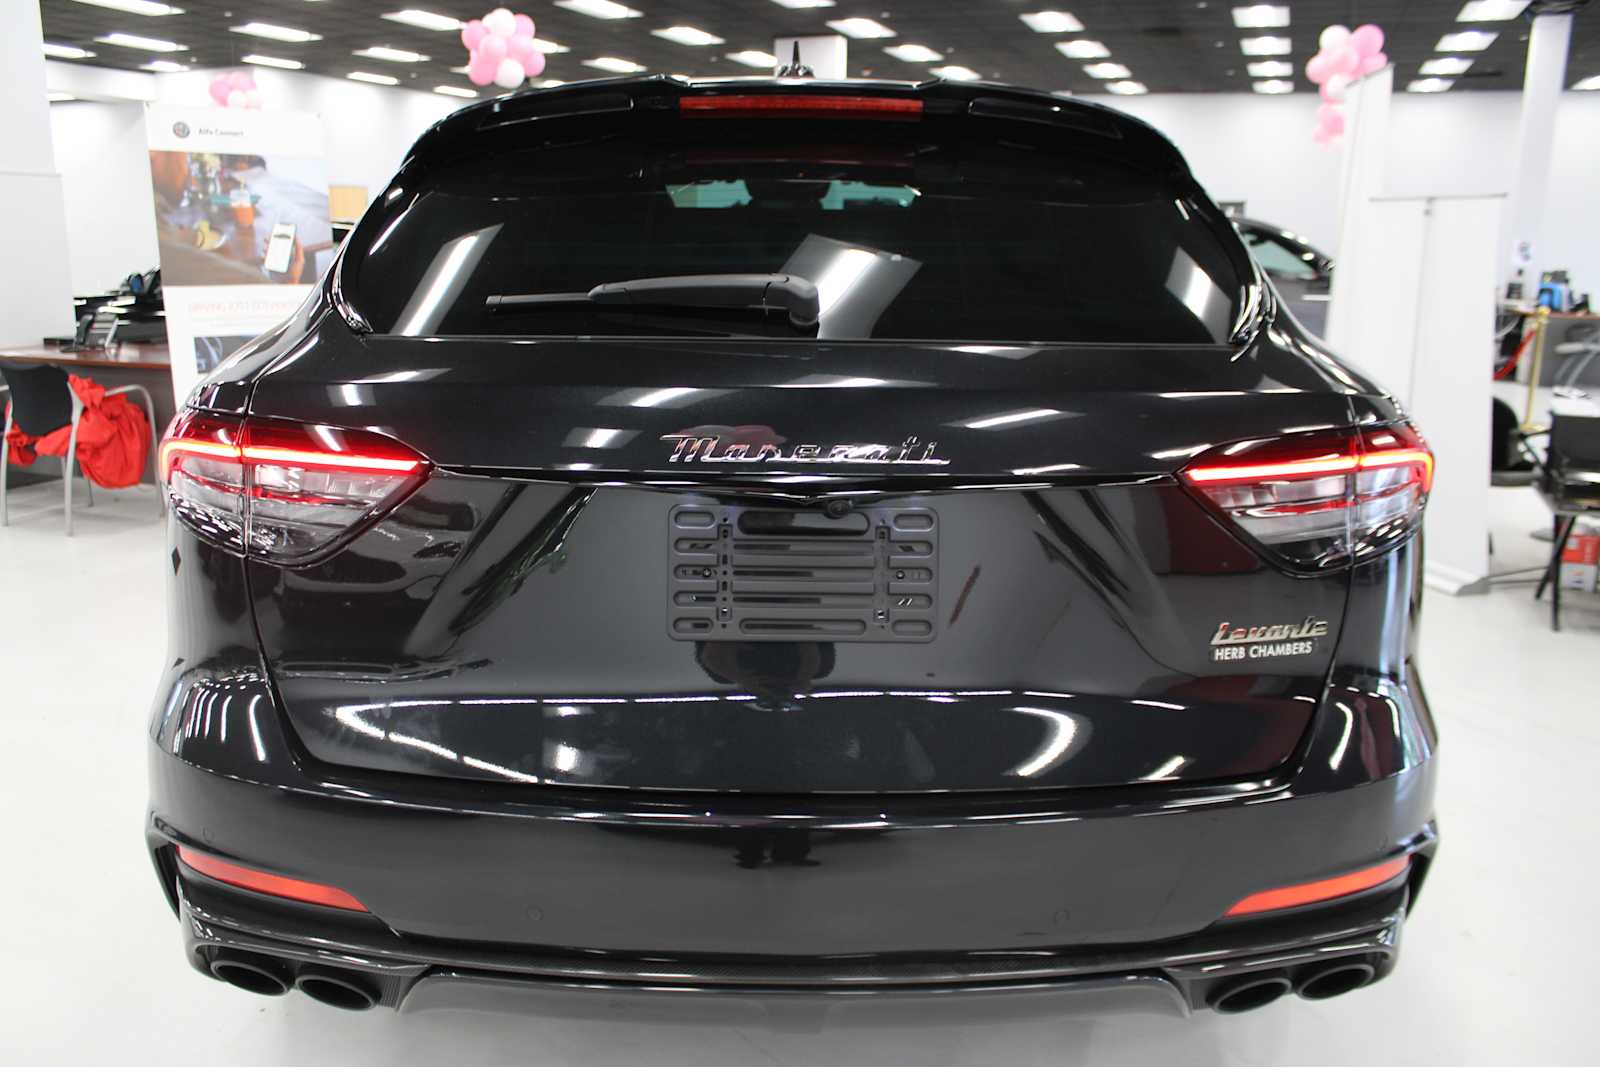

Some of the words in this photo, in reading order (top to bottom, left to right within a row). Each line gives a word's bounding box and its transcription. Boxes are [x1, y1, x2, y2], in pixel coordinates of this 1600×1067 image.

[660, 435, 950, 464] Maserati
[1210, 616, 1328, 645] Levante
[1214, 647, 1246, 661] HERB
[1249, 641, 1313, 658] CHAMBERS
